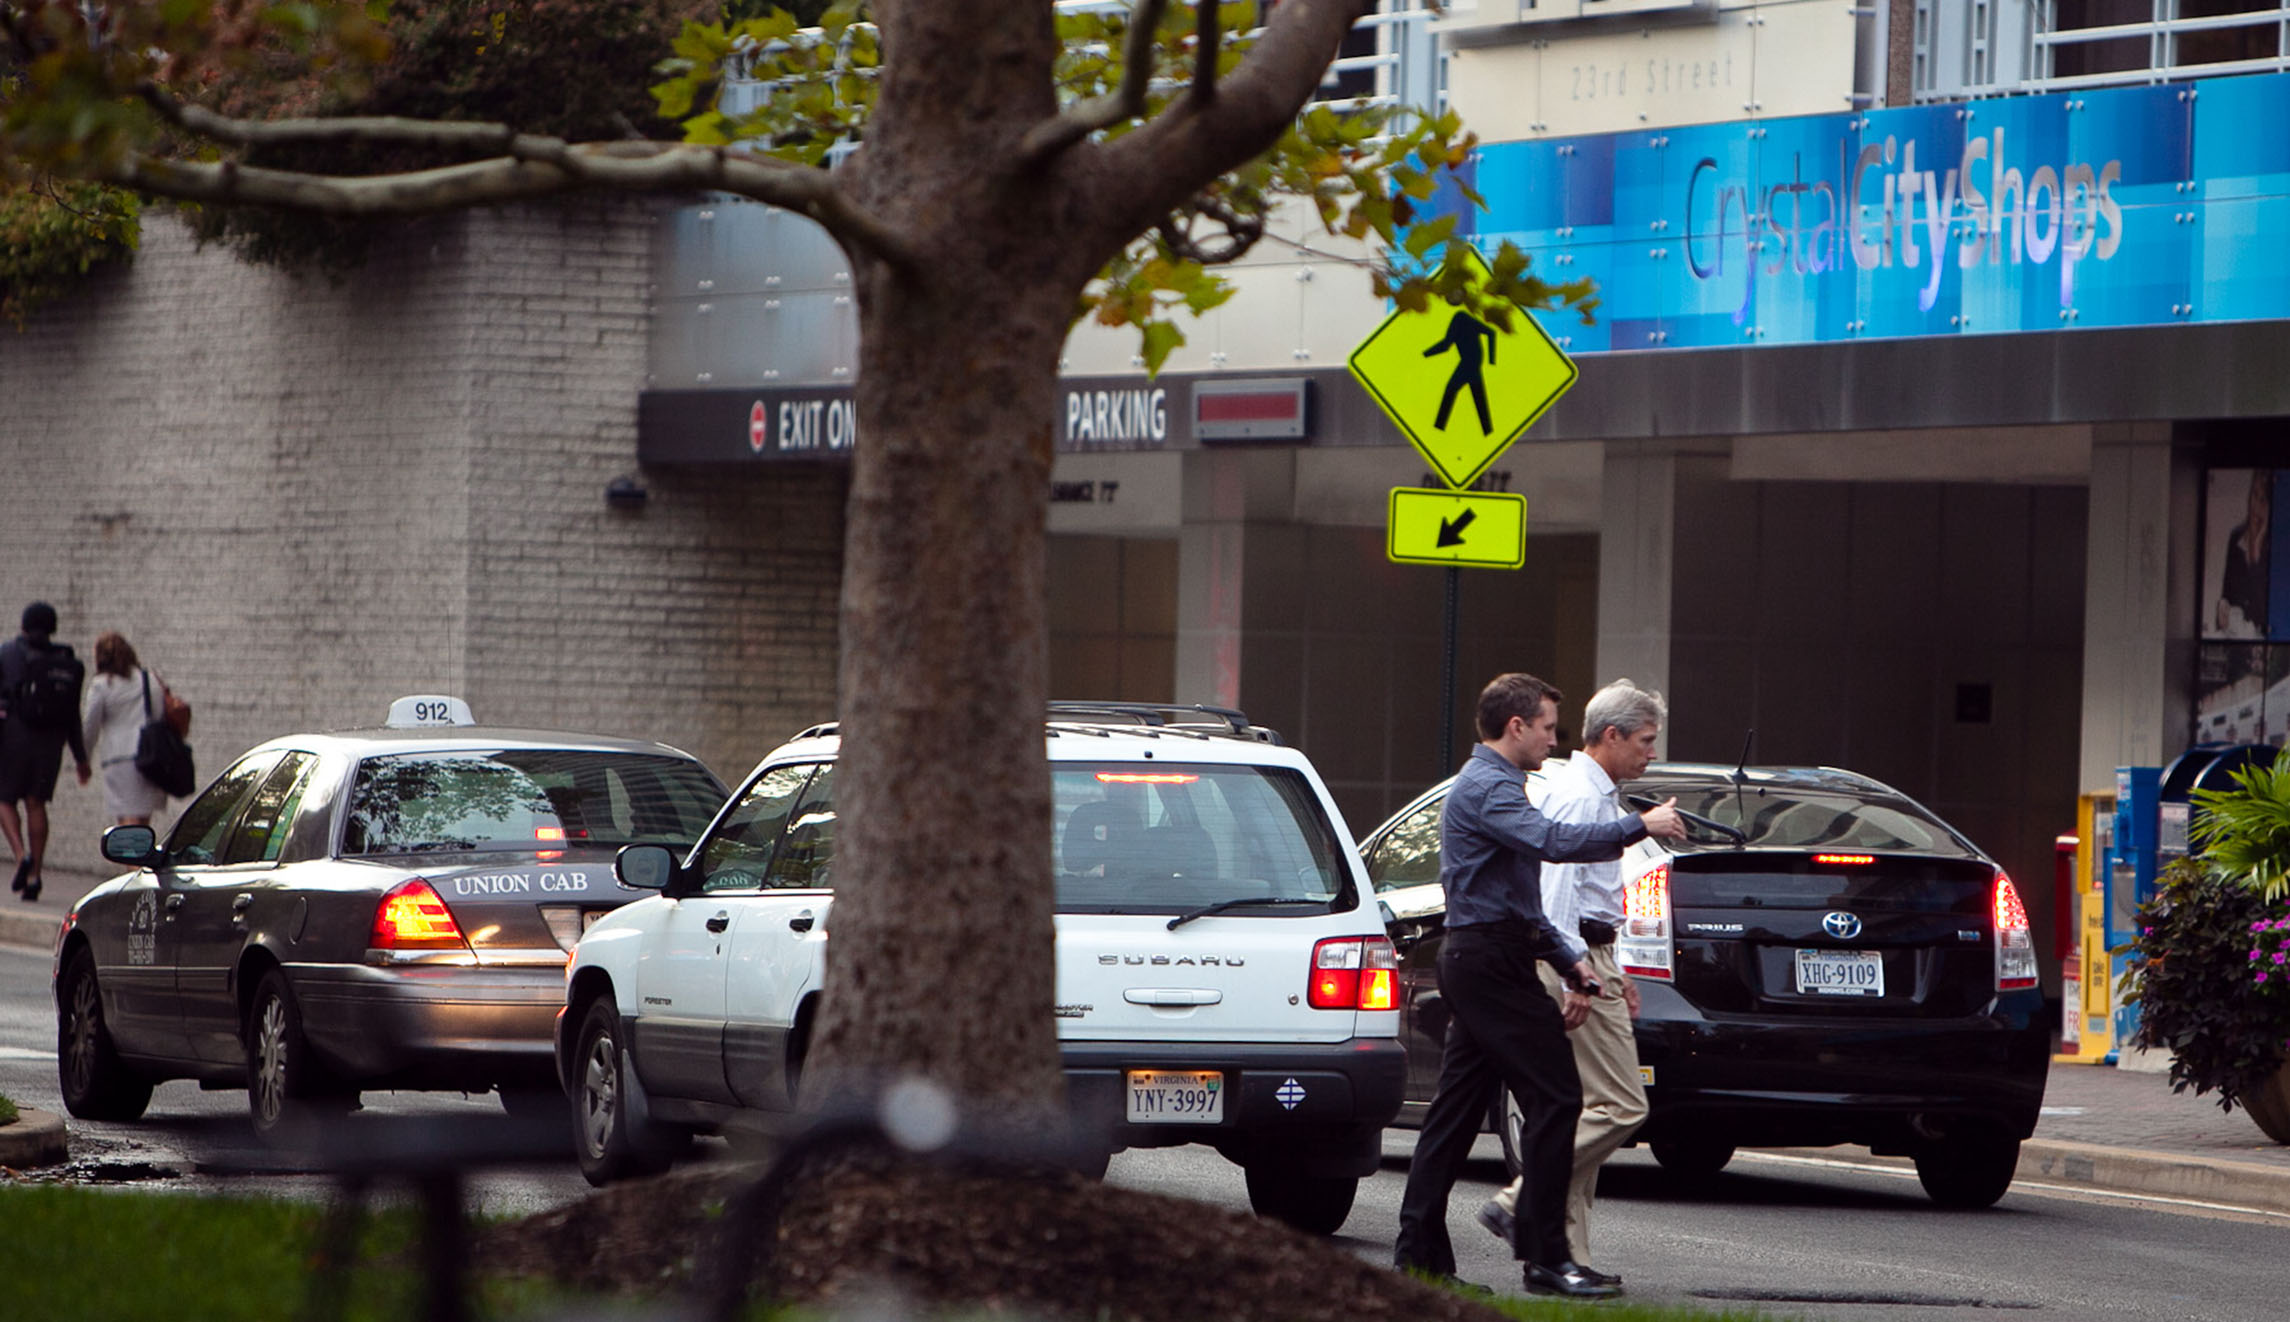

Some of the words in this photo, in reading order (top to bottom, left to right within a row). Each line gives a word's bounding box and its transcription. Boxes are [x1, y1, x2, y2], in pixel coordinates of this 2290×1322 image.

[1571, 62, 1627, 102] 23rd
[1646, 51, 1733, 94] Street
[779, 400, 824, 449] EXIT
[1066, 388, 1166, 441] PARKING
[415, 702, 448, 721] 912
[454, 874, 530, 895] UNION
[540, 872, 588, 892] CAB
[1687, 923, 1744, 933] PRIUS
[1098, 954, 1245, 967] SUBARU
[1802, 963, 1876, 985] XHG-9109
[1153, 1076, 1199, 1085] VIRGINIA
[1133, 1088, 1217, 1113] YNY-3997
